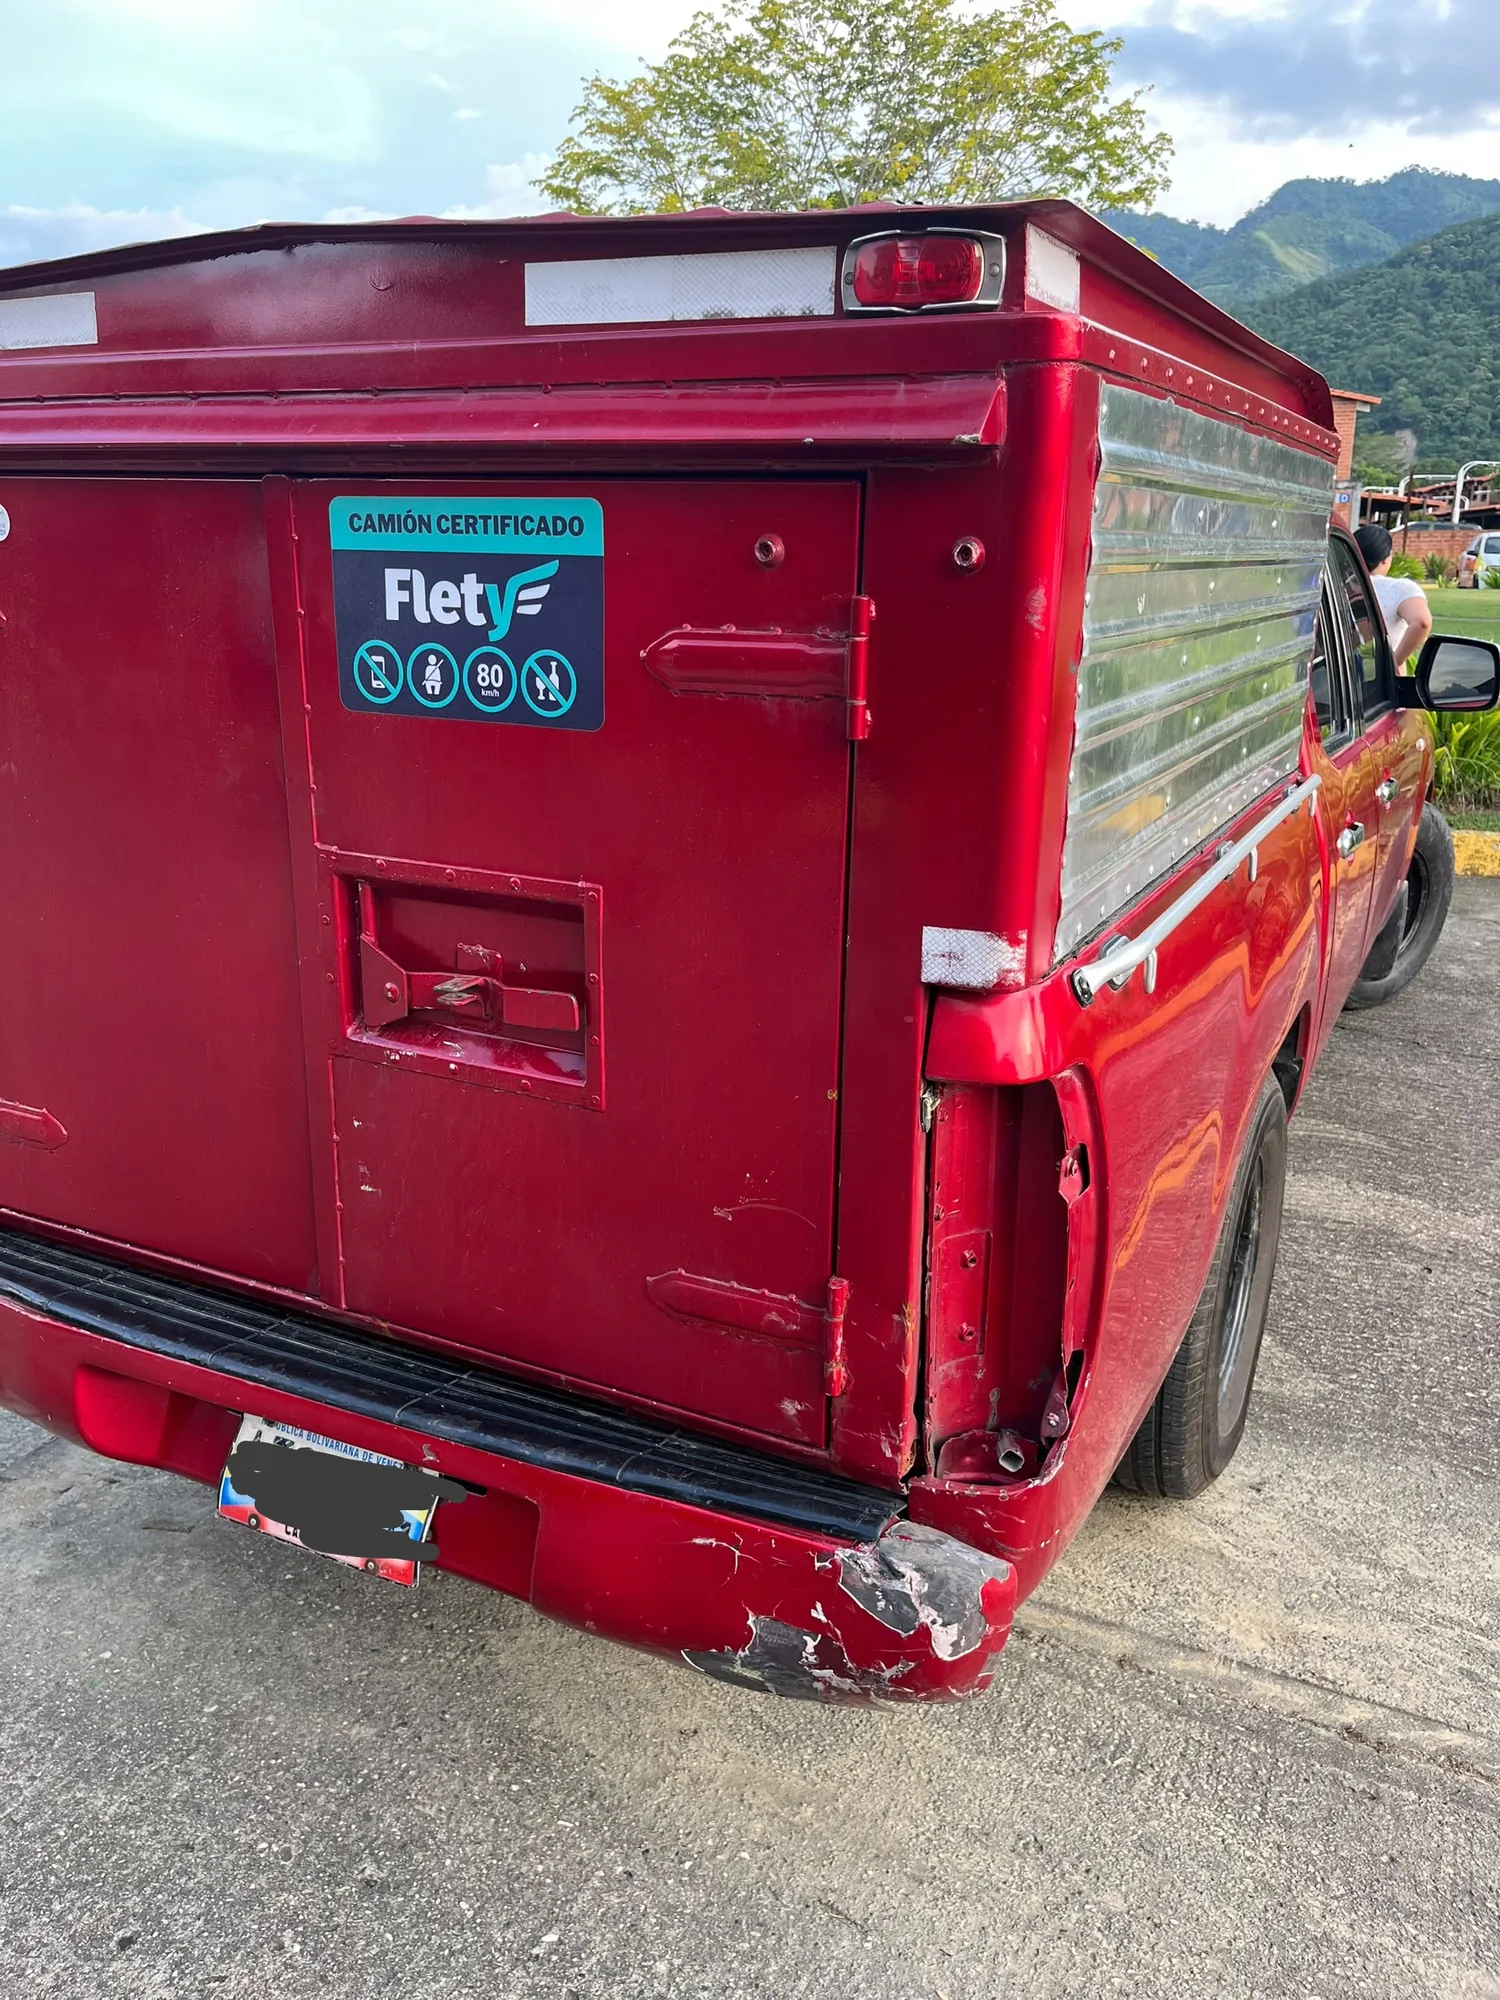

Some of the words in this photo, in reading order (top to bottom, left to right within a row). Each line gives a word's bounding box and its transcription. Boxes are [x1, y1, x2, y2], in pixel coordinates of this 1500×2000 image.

[349, 509, 432, 534] CAMIÓN
[436, 514, 585, 537] CERTIFICADO
[384, 559, 560, 642] Flety
[476, 663, 503, 688] 80
[481, 688, 500, 698] km/h
[306, 1431, 359, 1458] BOLIVARIANA
[362, 1451, 373, 1463] DE
